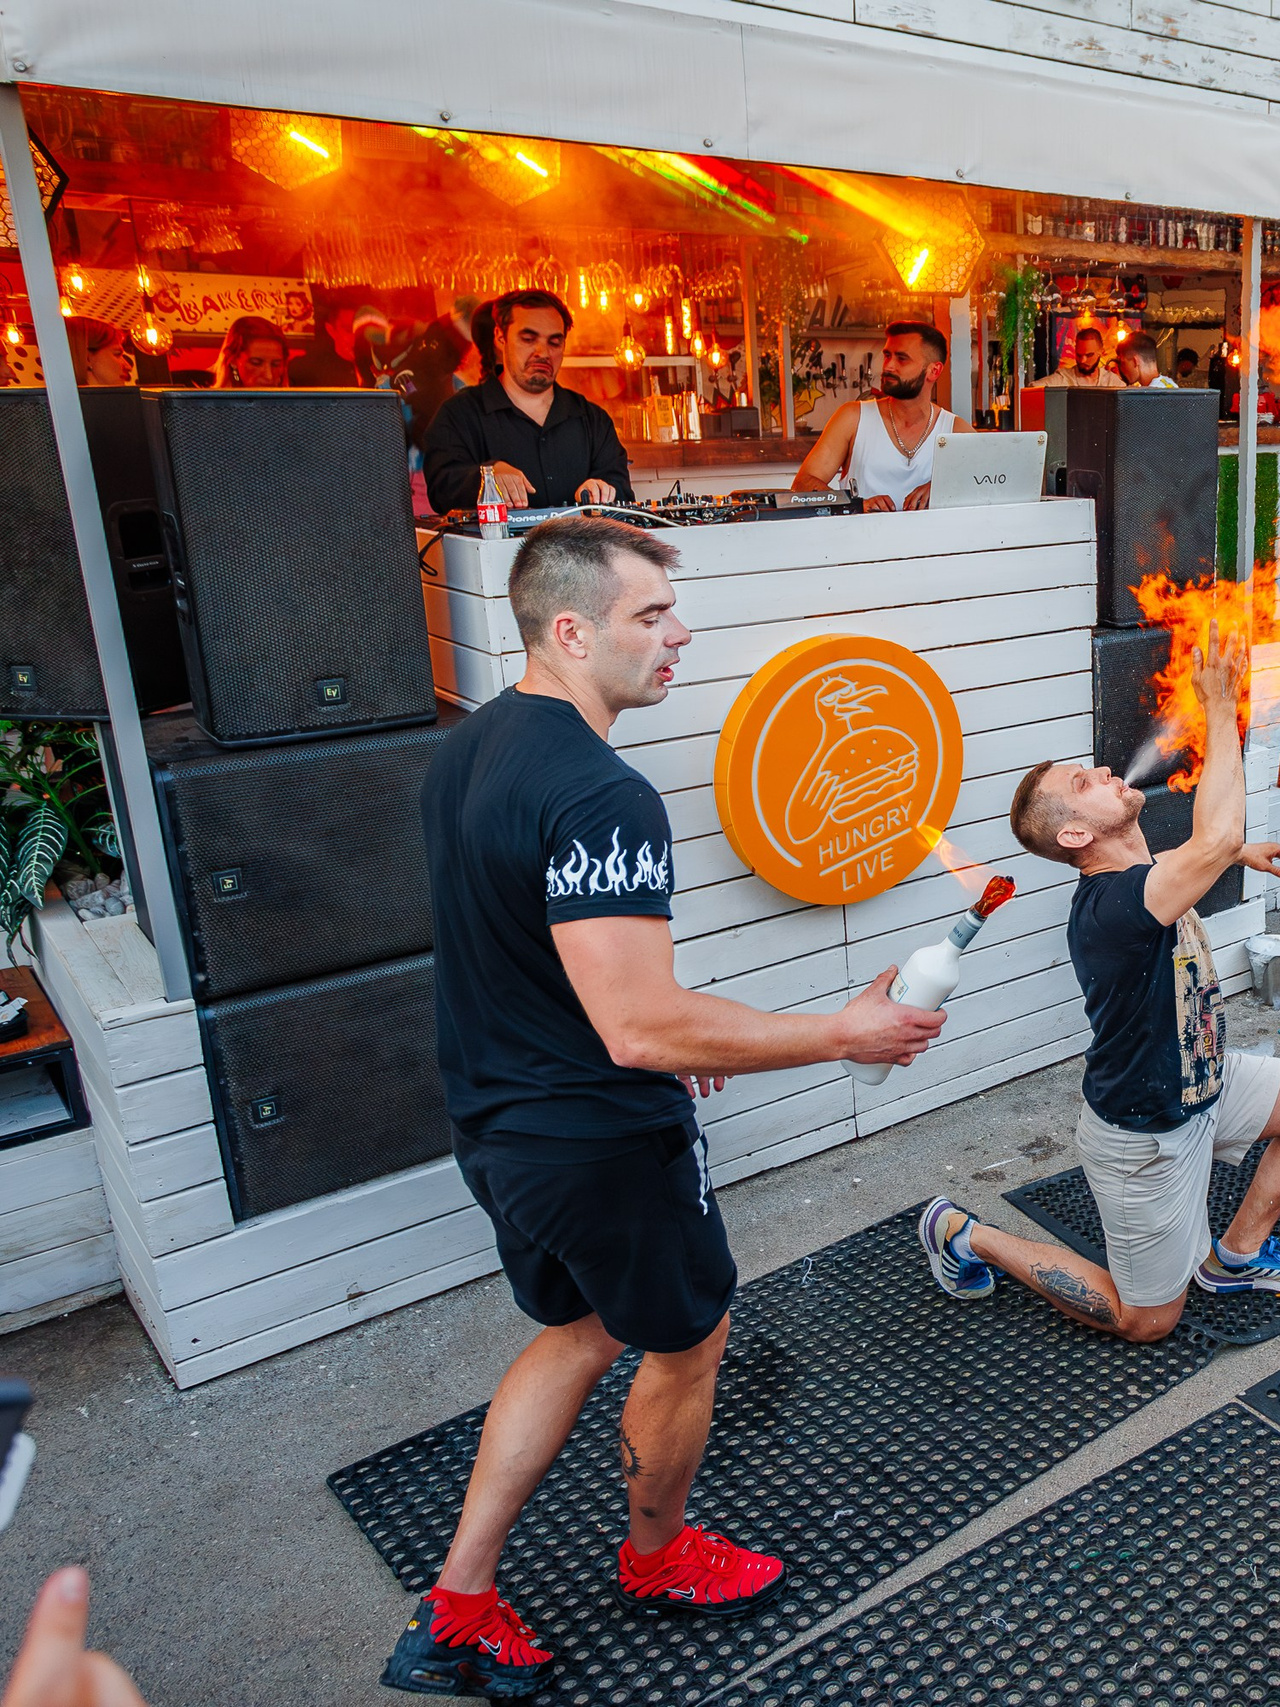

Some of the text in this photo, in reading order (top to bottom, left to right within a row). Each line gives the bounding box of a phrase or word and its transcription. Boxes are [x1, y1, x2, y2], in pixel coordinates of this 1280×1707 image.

[180, 288, 284, 325] BAKERY
[973, 474, 1007, 485] VAIO
[791, 495, 826, 503] Pioneer
[818, 800, 914, 865] HUNGRY
[842, 847, 895, 892] LIVE
